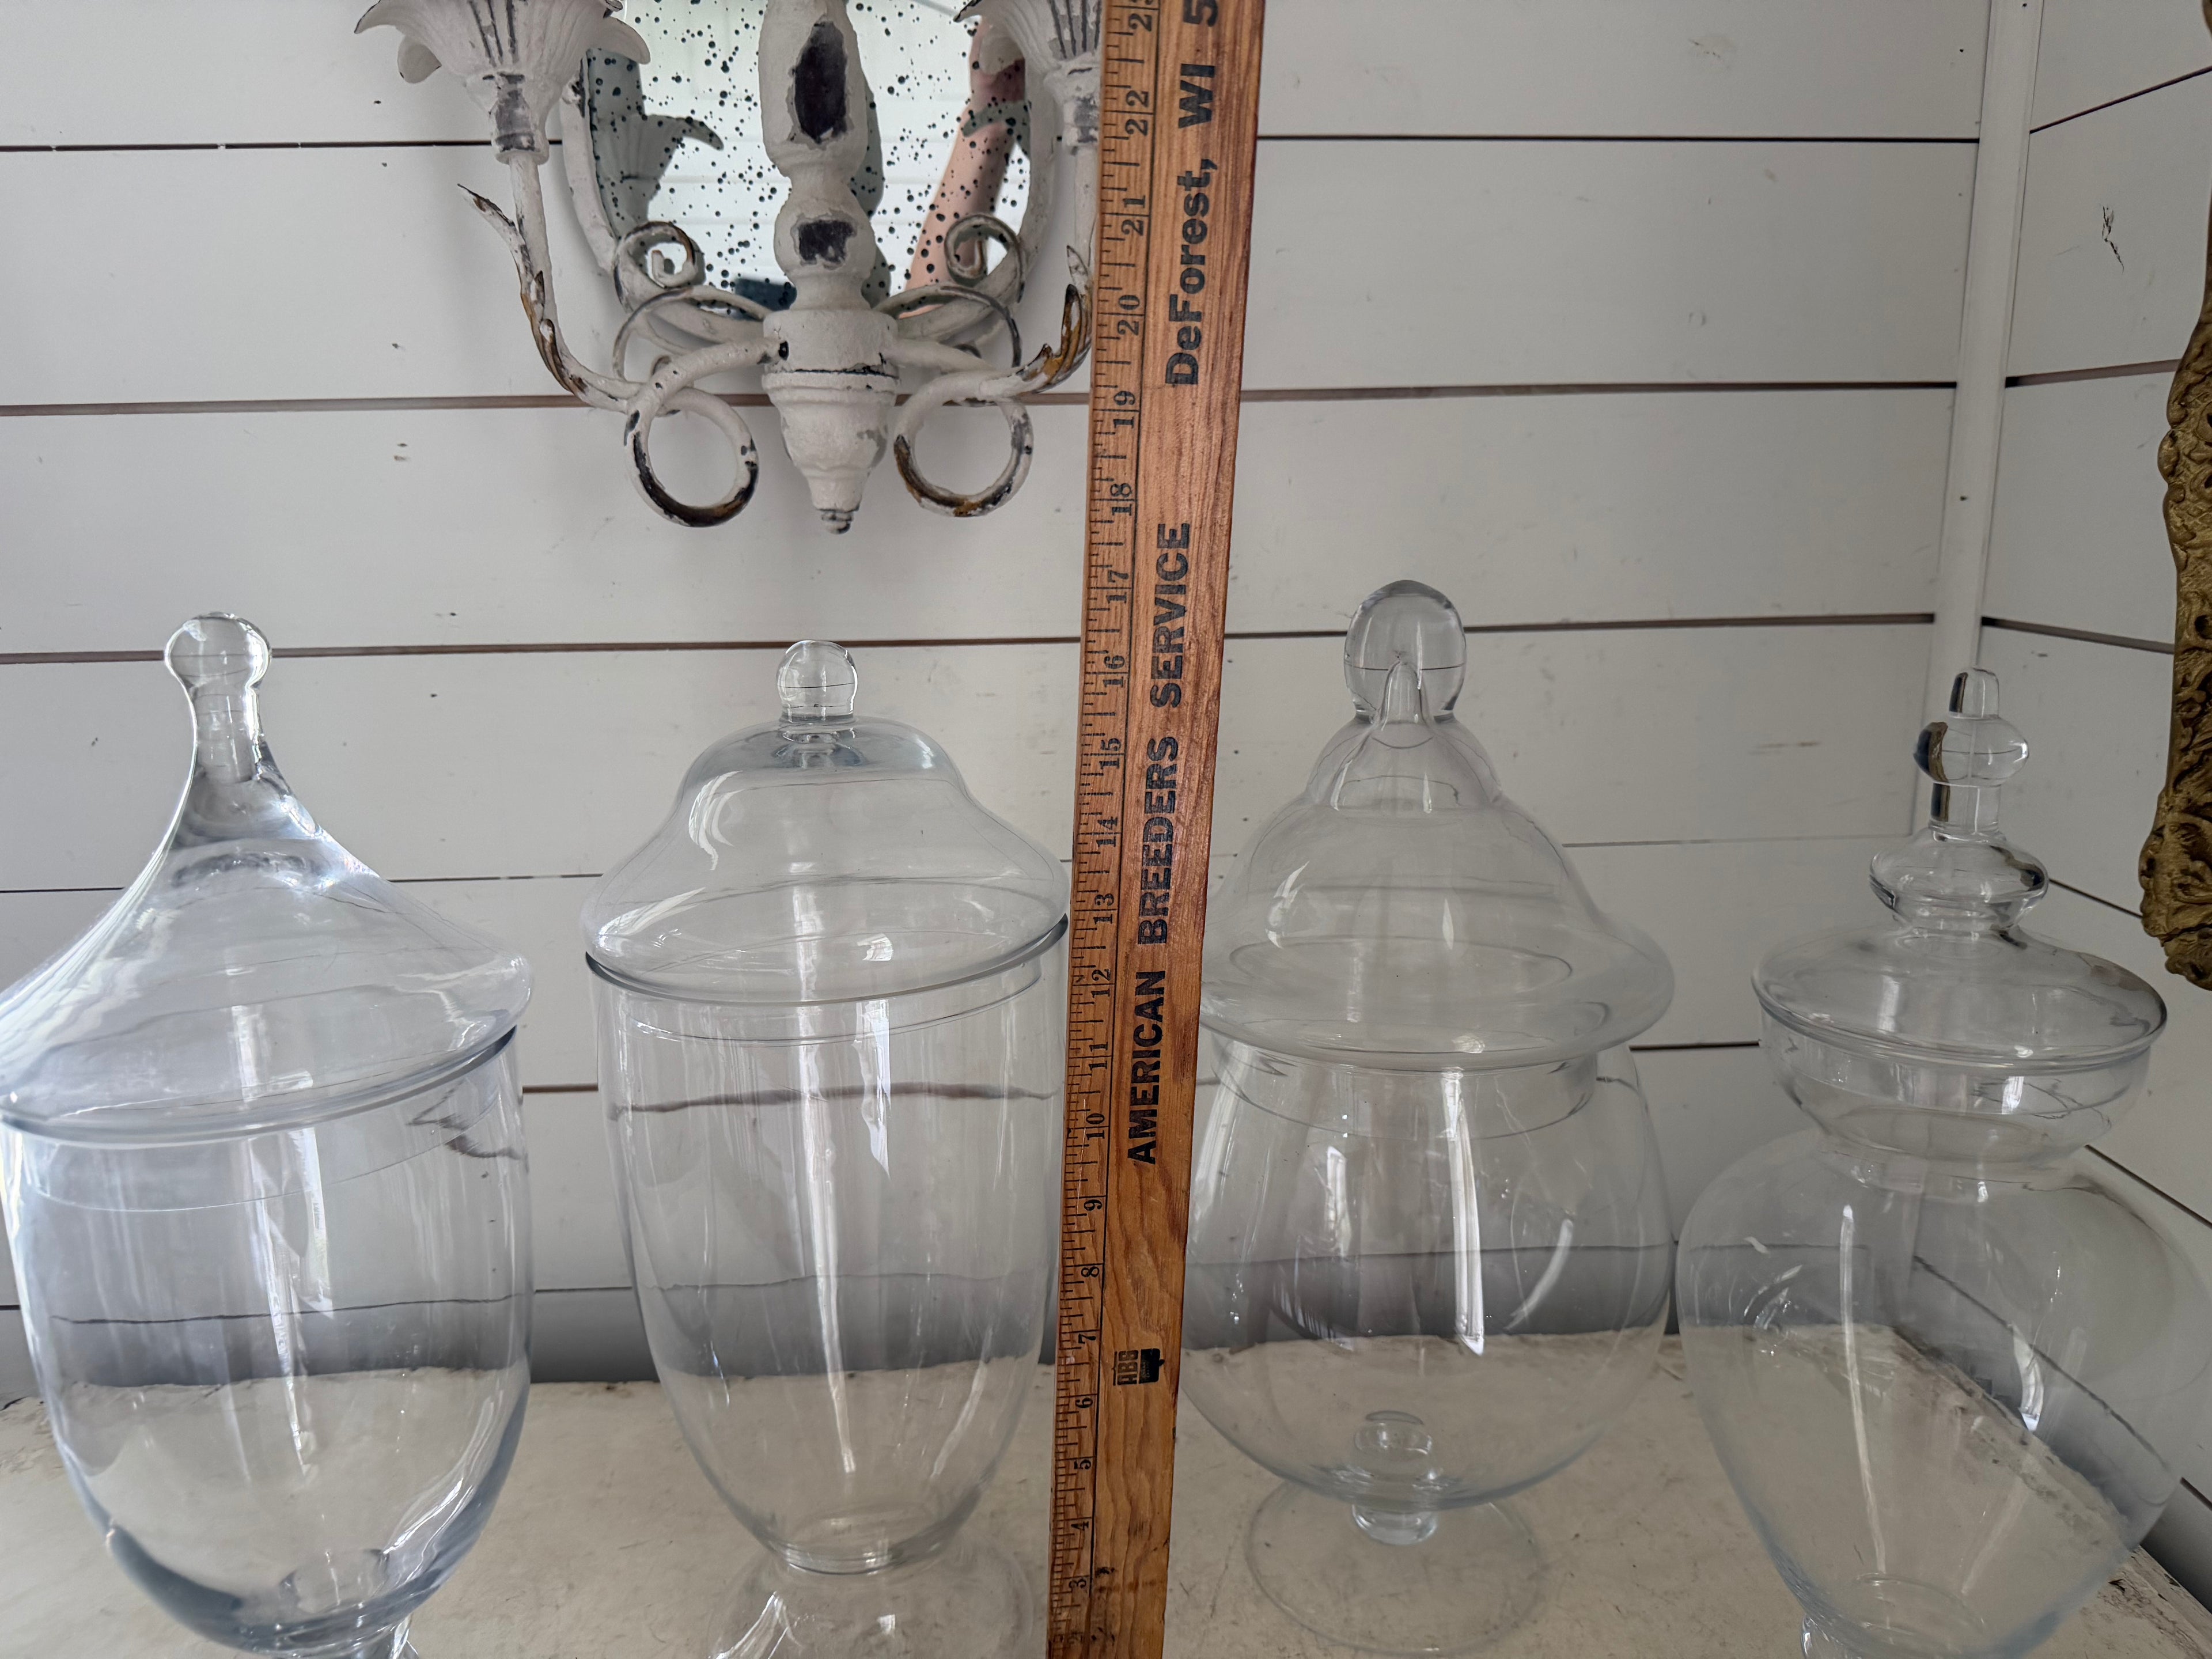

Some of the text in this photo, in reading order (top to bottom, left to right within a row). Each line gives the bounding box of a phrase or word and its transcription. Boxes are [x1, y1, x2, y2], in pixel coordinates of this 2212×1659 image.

[1128, 0, 1152, 32] 2
[1178, 63, 1215, 128] WI
[1124, 90, 1150, 136] 22
[1120, 195, 1146, 236] 21
[1165, 158, 1218, 385] DeForest,
[1118, 294, 1140, 336] 20
[1113, 391, 1135, 429] 19
[1109, 483, 1132, 516] 18
[1105, 570, 1129, 604] 17
[1103, 655, 1125, 688] 16
[1099, 738, 1122, 769] 15
[1096, 816, 1118, 847] 14
[1127, 523, 1190, 1165] AMERICAN BREEDERS SERVICE
[1093, 893, 1115, 925] 13
[1091, 968, 1111, 998] 12
[1088, 1041, 1108, 1071] 11
[1085, 1112, 1105, 1141] 10
[1084, 1199, 1103, 1211] 9
[1081, 1266, 1100, 1278] 8
[1078, 1334, 1096, 1344] 7
[1075, 1397, 1094, 1408] 6
[1073, 1459, 1092, 1470] 5
[1071, 1521, 1089, 1531] 4
[1069, 1578, 1086, 1590] 3
